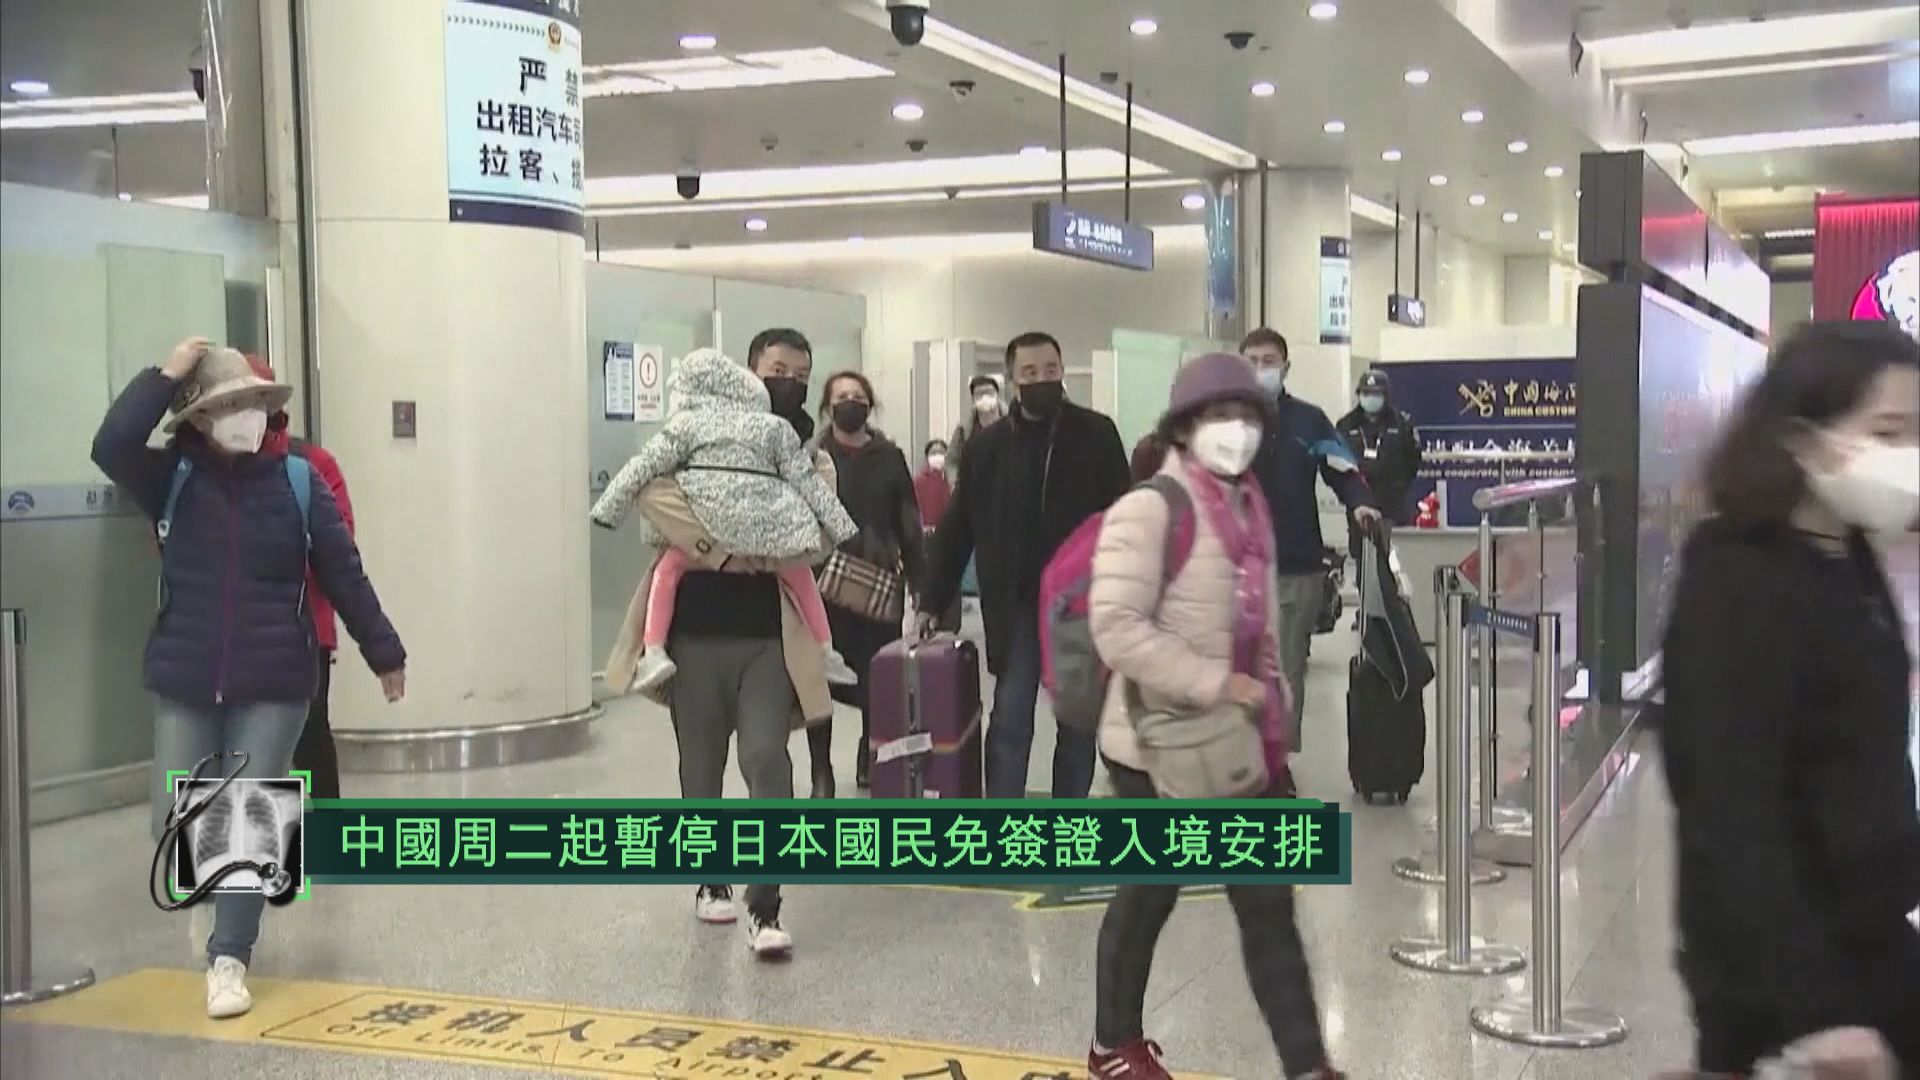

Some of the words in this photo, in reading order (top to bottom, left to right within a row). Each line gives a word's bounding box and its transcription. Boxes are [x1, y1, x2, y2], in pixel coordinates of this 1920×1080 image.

[1503, 406, 1534, 417] CHINA
[327, 1023, 391, 1038] Off
[414, 1032, 544, 1054] Limits
[579, 1048, 625, 1062] To
